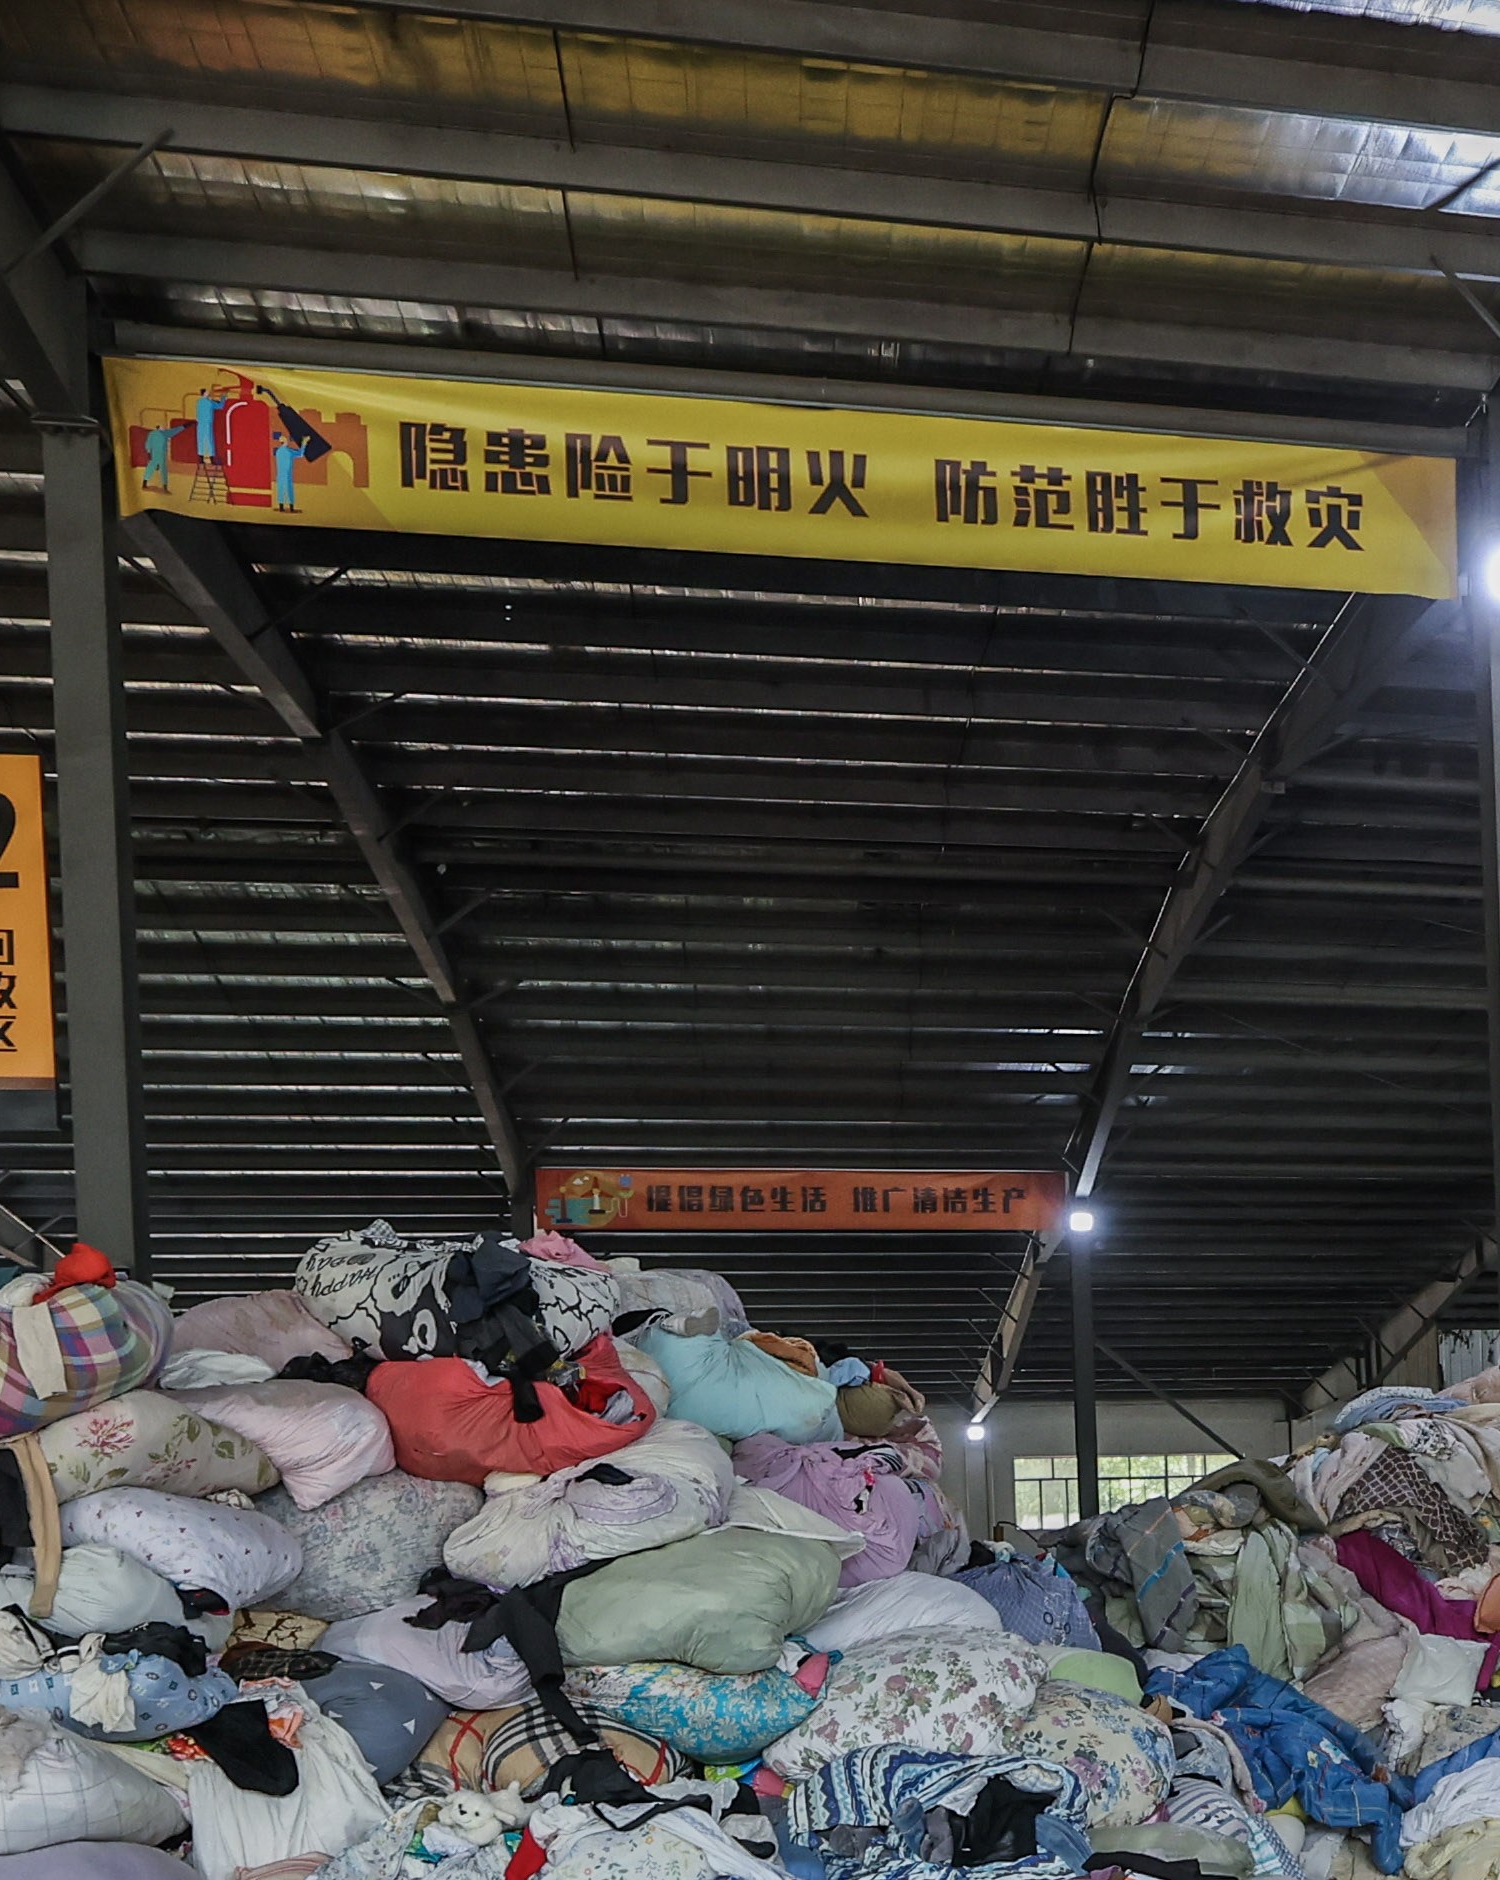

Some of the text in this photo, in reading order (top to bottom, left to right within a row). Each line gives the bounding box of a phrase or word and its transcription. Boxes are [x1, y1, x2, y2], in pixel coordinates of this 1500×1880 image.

[399, 422, 1365, 552] 隐患险于明火 防范胜于救灾
[646, 1185, 1026, 1214] 提倡绿色生活 推广清洁生产
[311, 1265, 379, 1298] HAPPY
